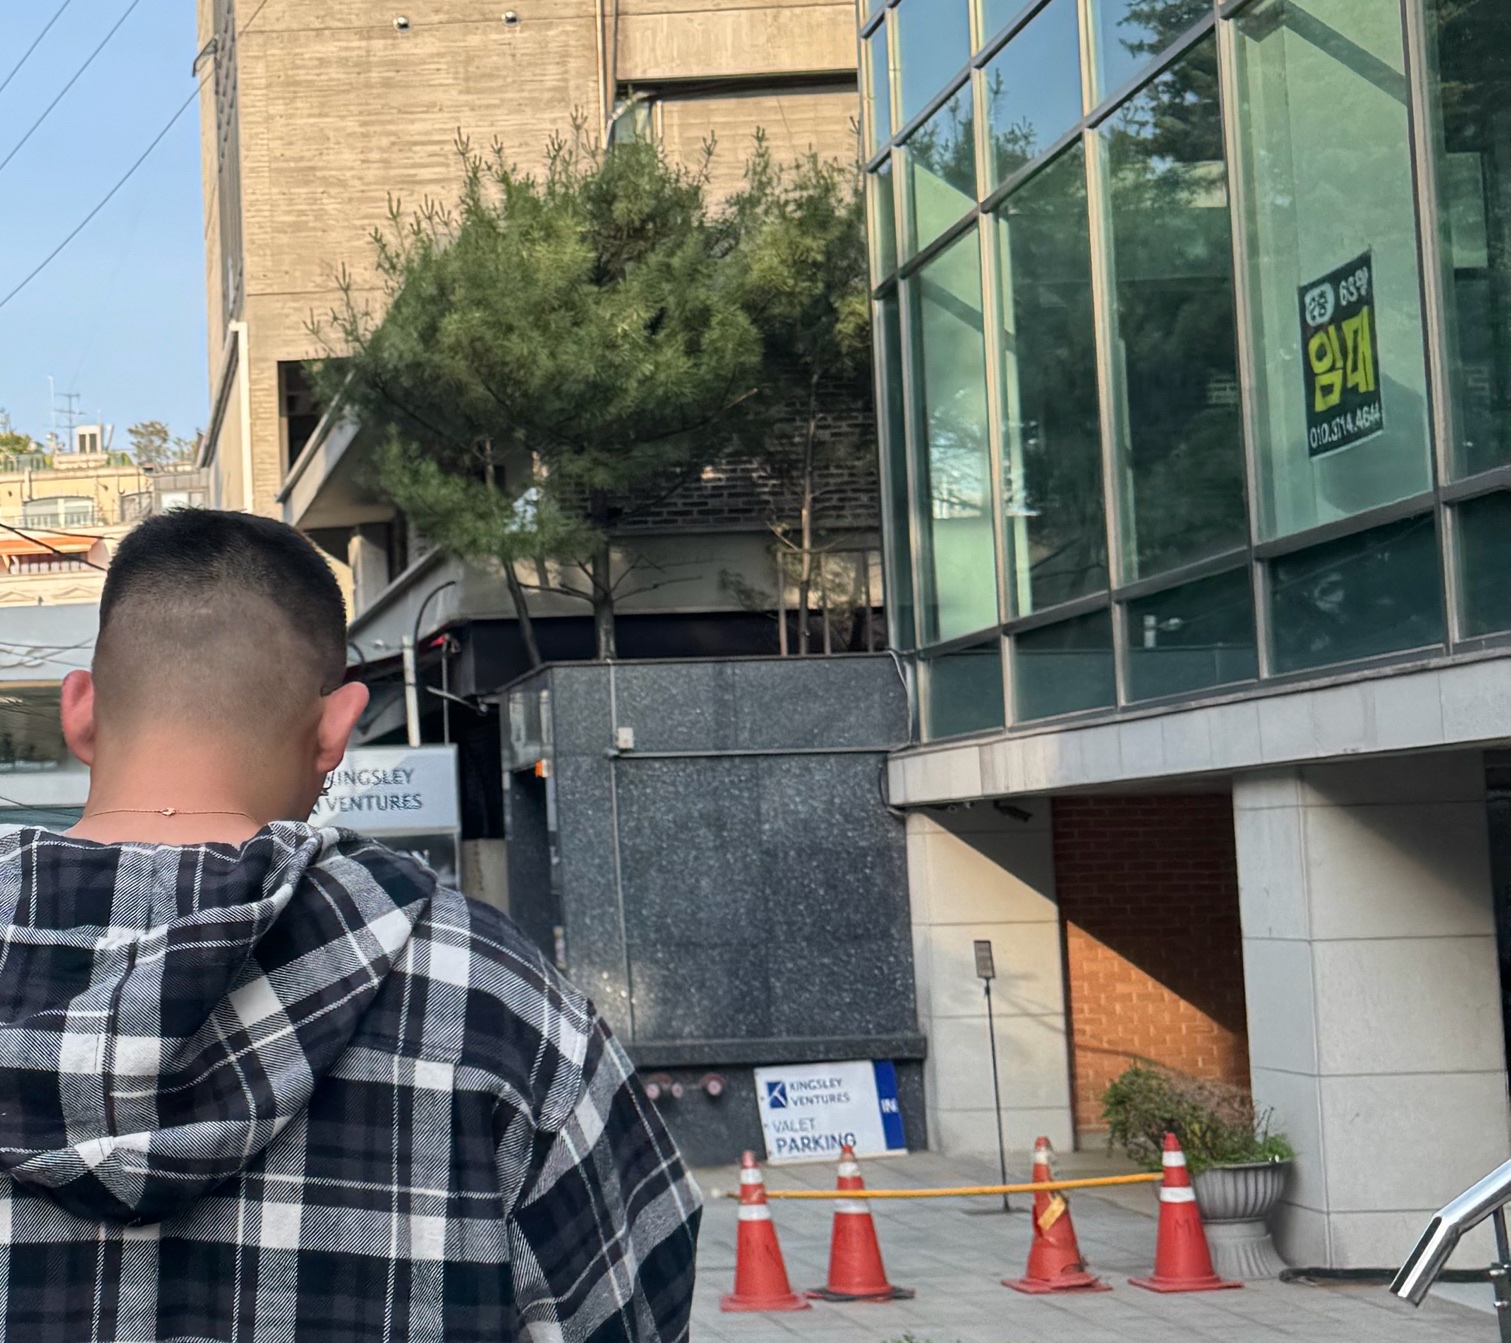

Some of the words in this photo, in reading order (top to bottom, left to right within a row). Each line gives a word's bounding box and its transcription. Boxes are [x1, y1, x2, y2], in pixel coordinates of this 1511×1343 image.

[1307, 305, 1375, 413] 임대
[326, 768, 415, 786] INGSLEY
[325, 793, 423, 813] VENTURES
[789, 1077, 843, 1092] KINGSLEY
[790, 1092, 851, 1107] VENTURES
[771, 1117, 816, 1133] VALET
[775, 1132, 857, 1154] PARKING
